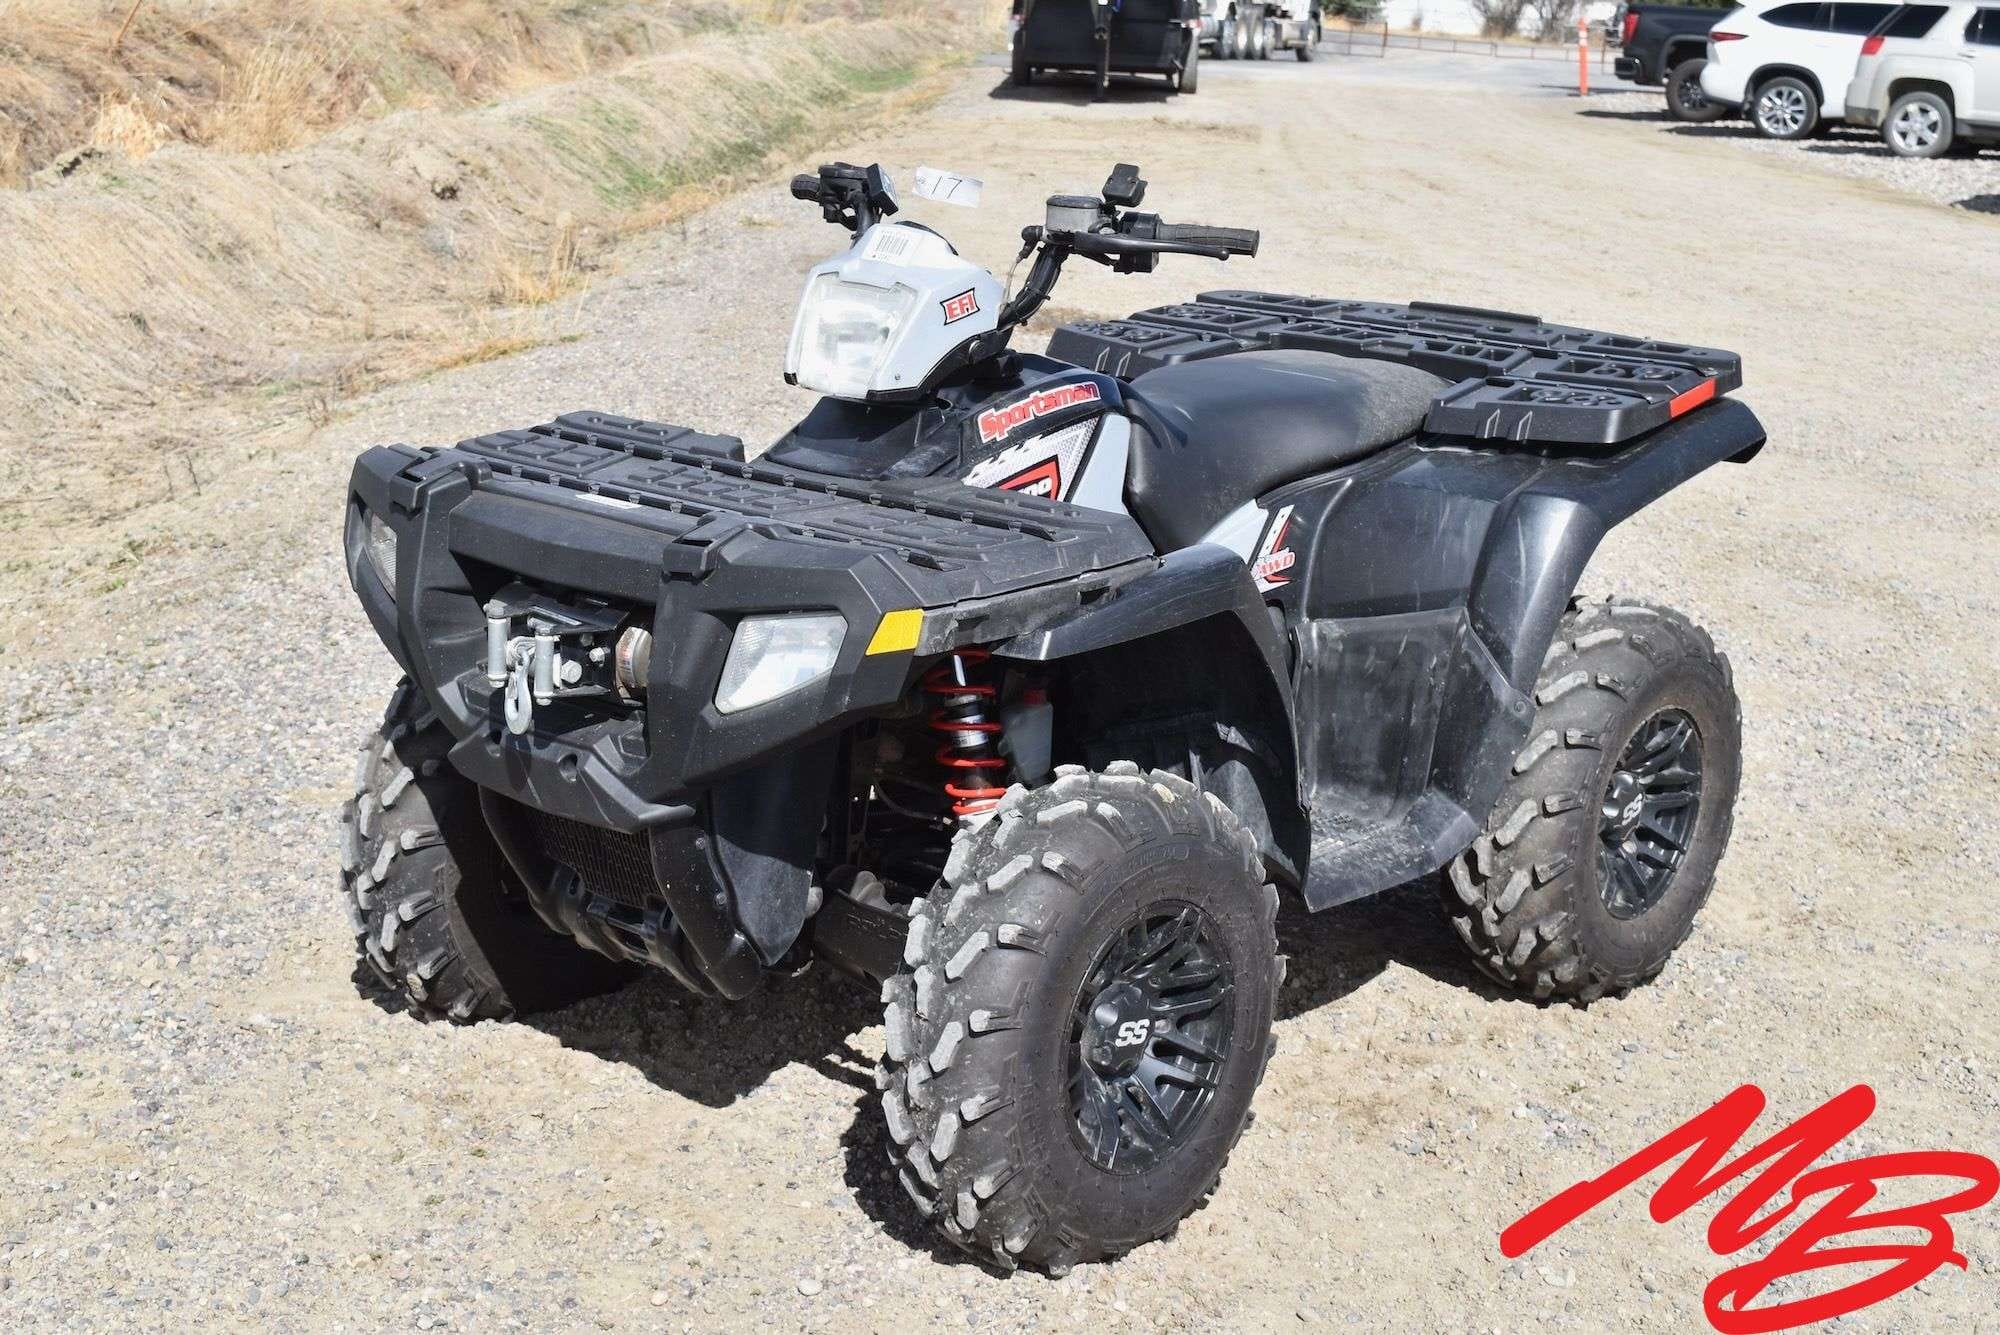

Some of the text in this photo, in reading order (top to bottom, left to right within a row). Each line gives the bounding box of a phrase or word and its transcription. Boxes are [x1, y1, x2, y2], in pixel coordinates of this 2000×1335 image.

[945, 293, 976, 321] EFI
[979, 382, 1100, 442] Sportsman
[1115, 1018, 1150, 1047] SS
